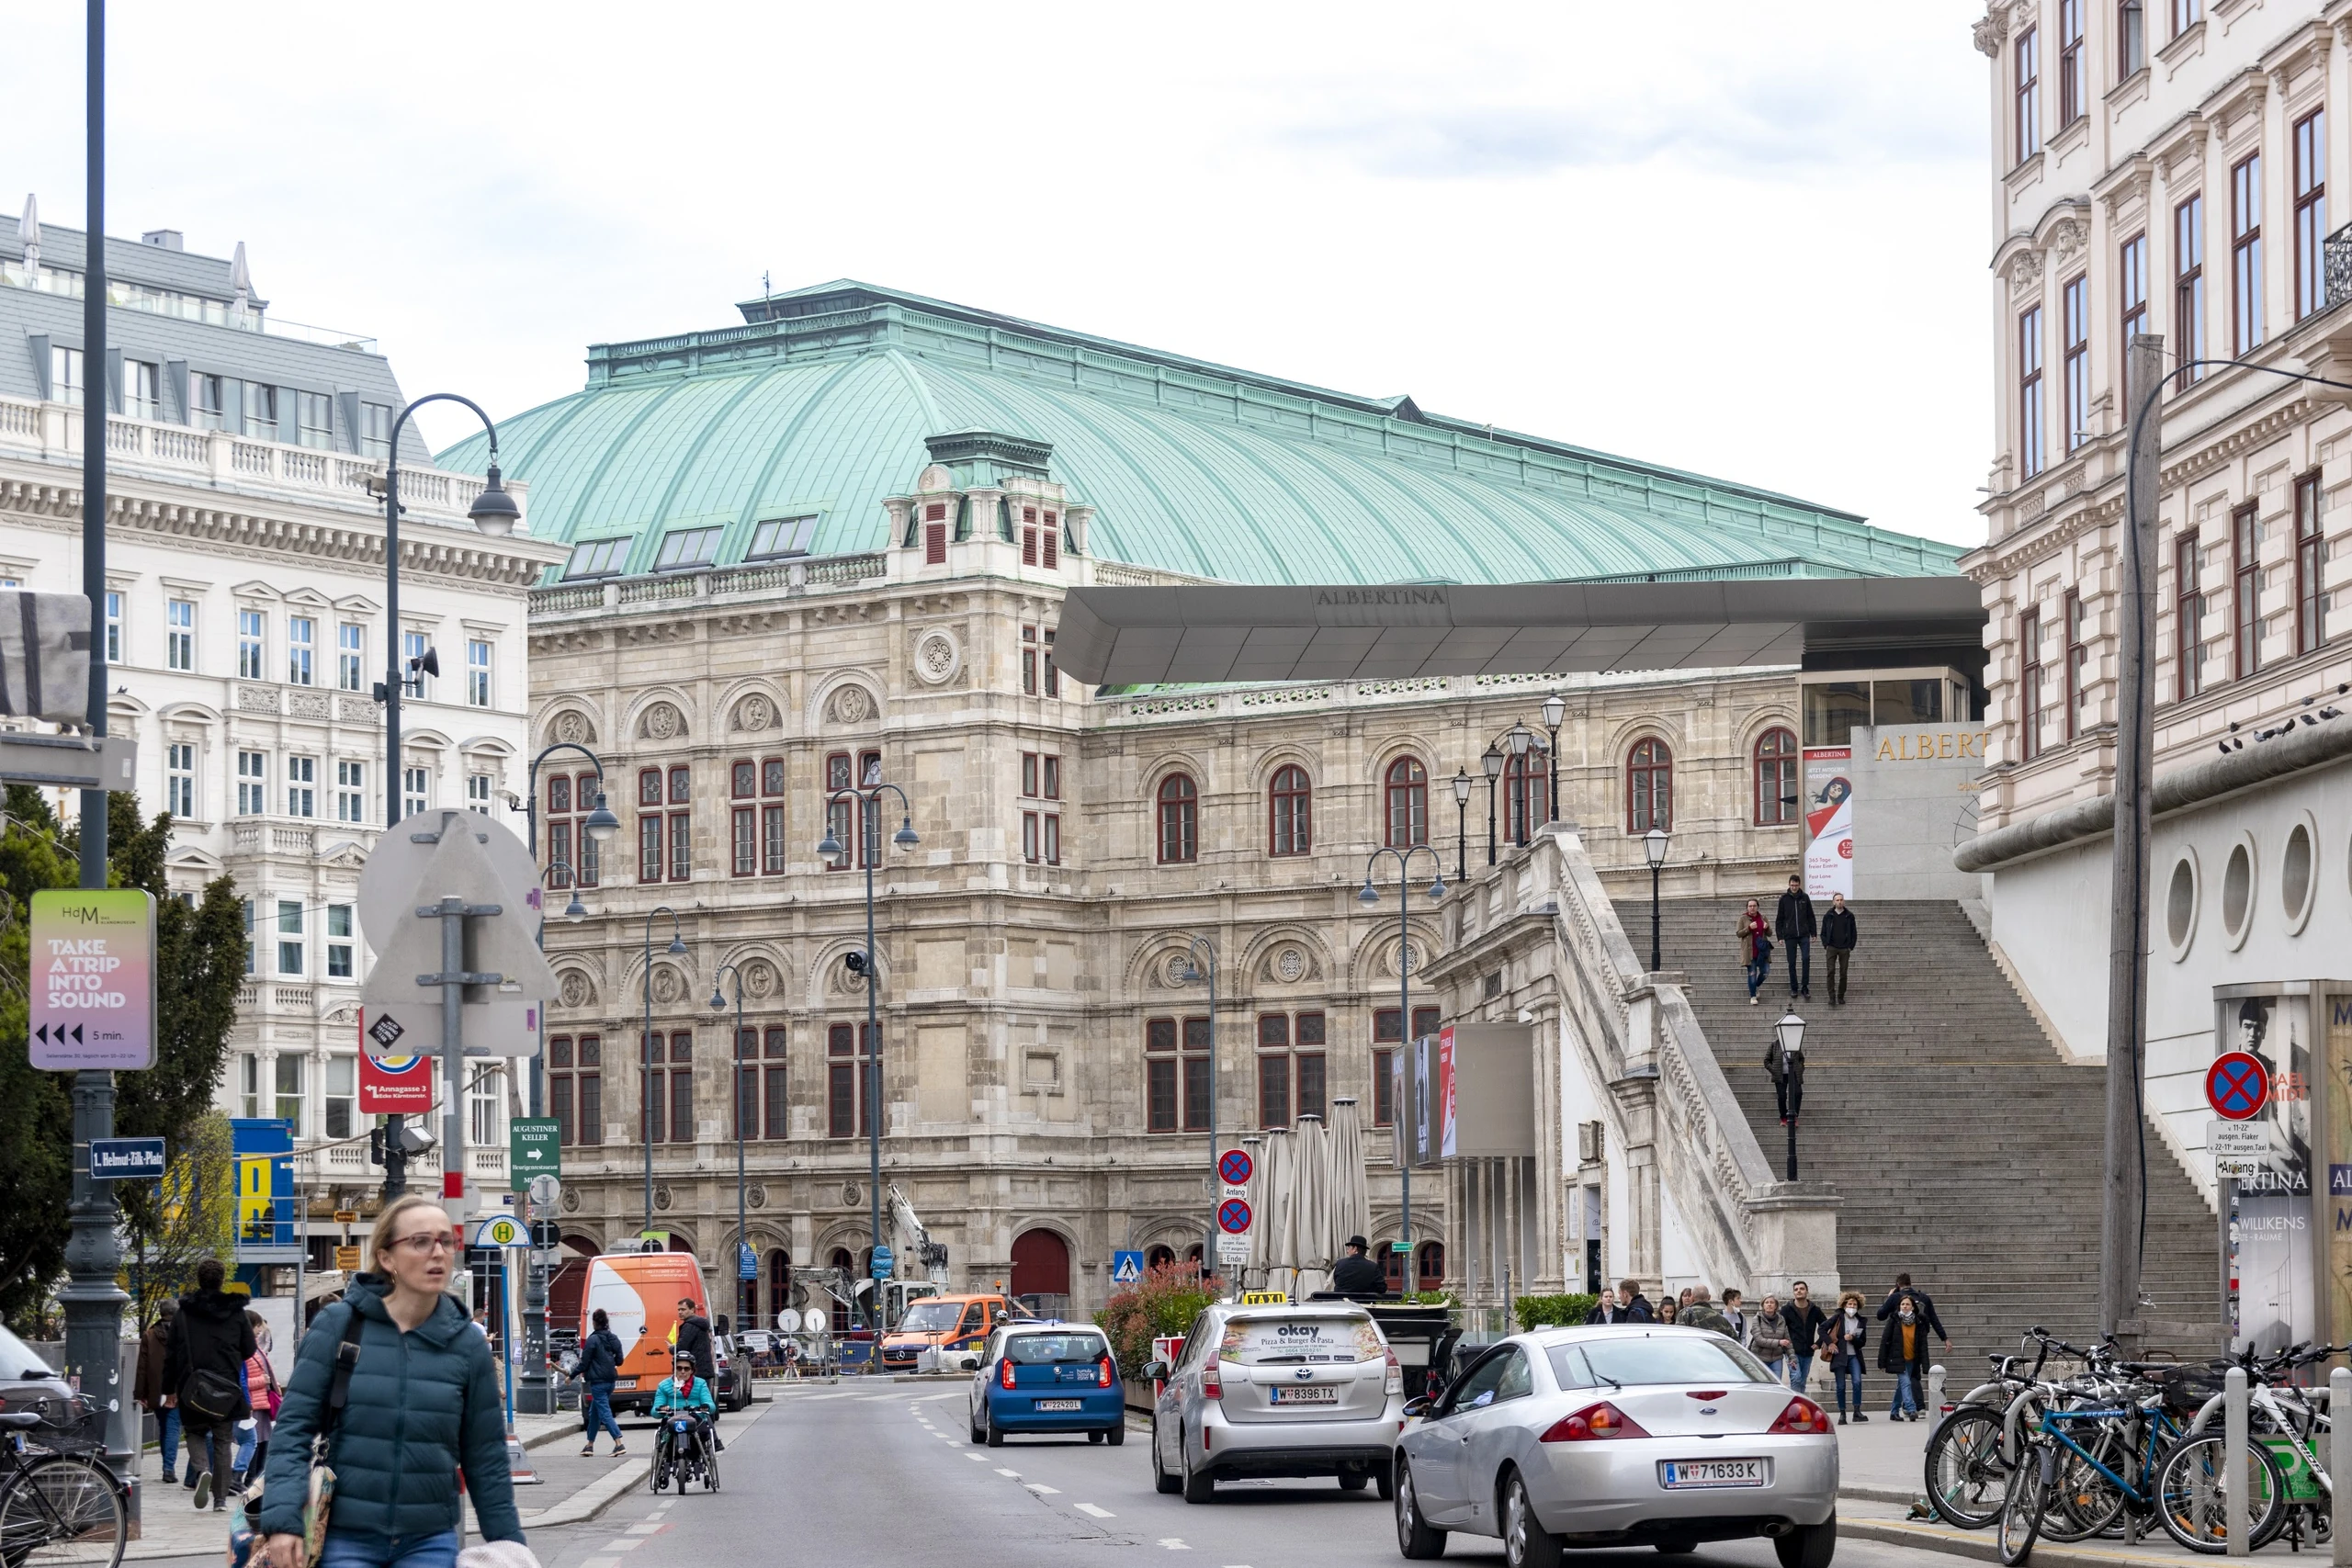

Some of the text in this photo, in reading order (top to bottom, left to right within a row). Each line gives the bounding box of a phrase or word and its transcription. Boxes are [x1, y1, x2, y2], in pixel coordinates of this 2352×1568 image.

[1317, 590, 1445, 605] ALBERTINA
[62, 907, 98, 924] HdM
[48, 939, 107, 955] TAKE
[50, 957, 121, 973] A TRIP
[48, 974, 103, 991] INTO
[48, 992, 127, 1009] SOUND
[93, 1031, 125, 1041] 5 min.
[102, 1151, 163, 1167] Helmut-Zilk-Platz
[1226, 1189, 1245, 1198] Anfang
[2240, 1216, 2305, 1230] WILLIKENS
[498, 1226, 509, 1240] H
[2254, 1231, 2283, 1242] RÄUME
[1249, 1294, 1282, 1304] TAXI
[1277, 1324, 1319, 1338] okay
[1261, 1337, 1278, 1346] Pizza
[1287, 1337, 1308, 1345] Burger
[1279, 1389, 1286, 1399] W
[1295, 1388, 1320, 1399] 8396
[1322, 1388, 1335, 1399] TX
[2280, 1418, 2324, 1474] MERIDA
[1678, 1465, 1689, 1480] W
